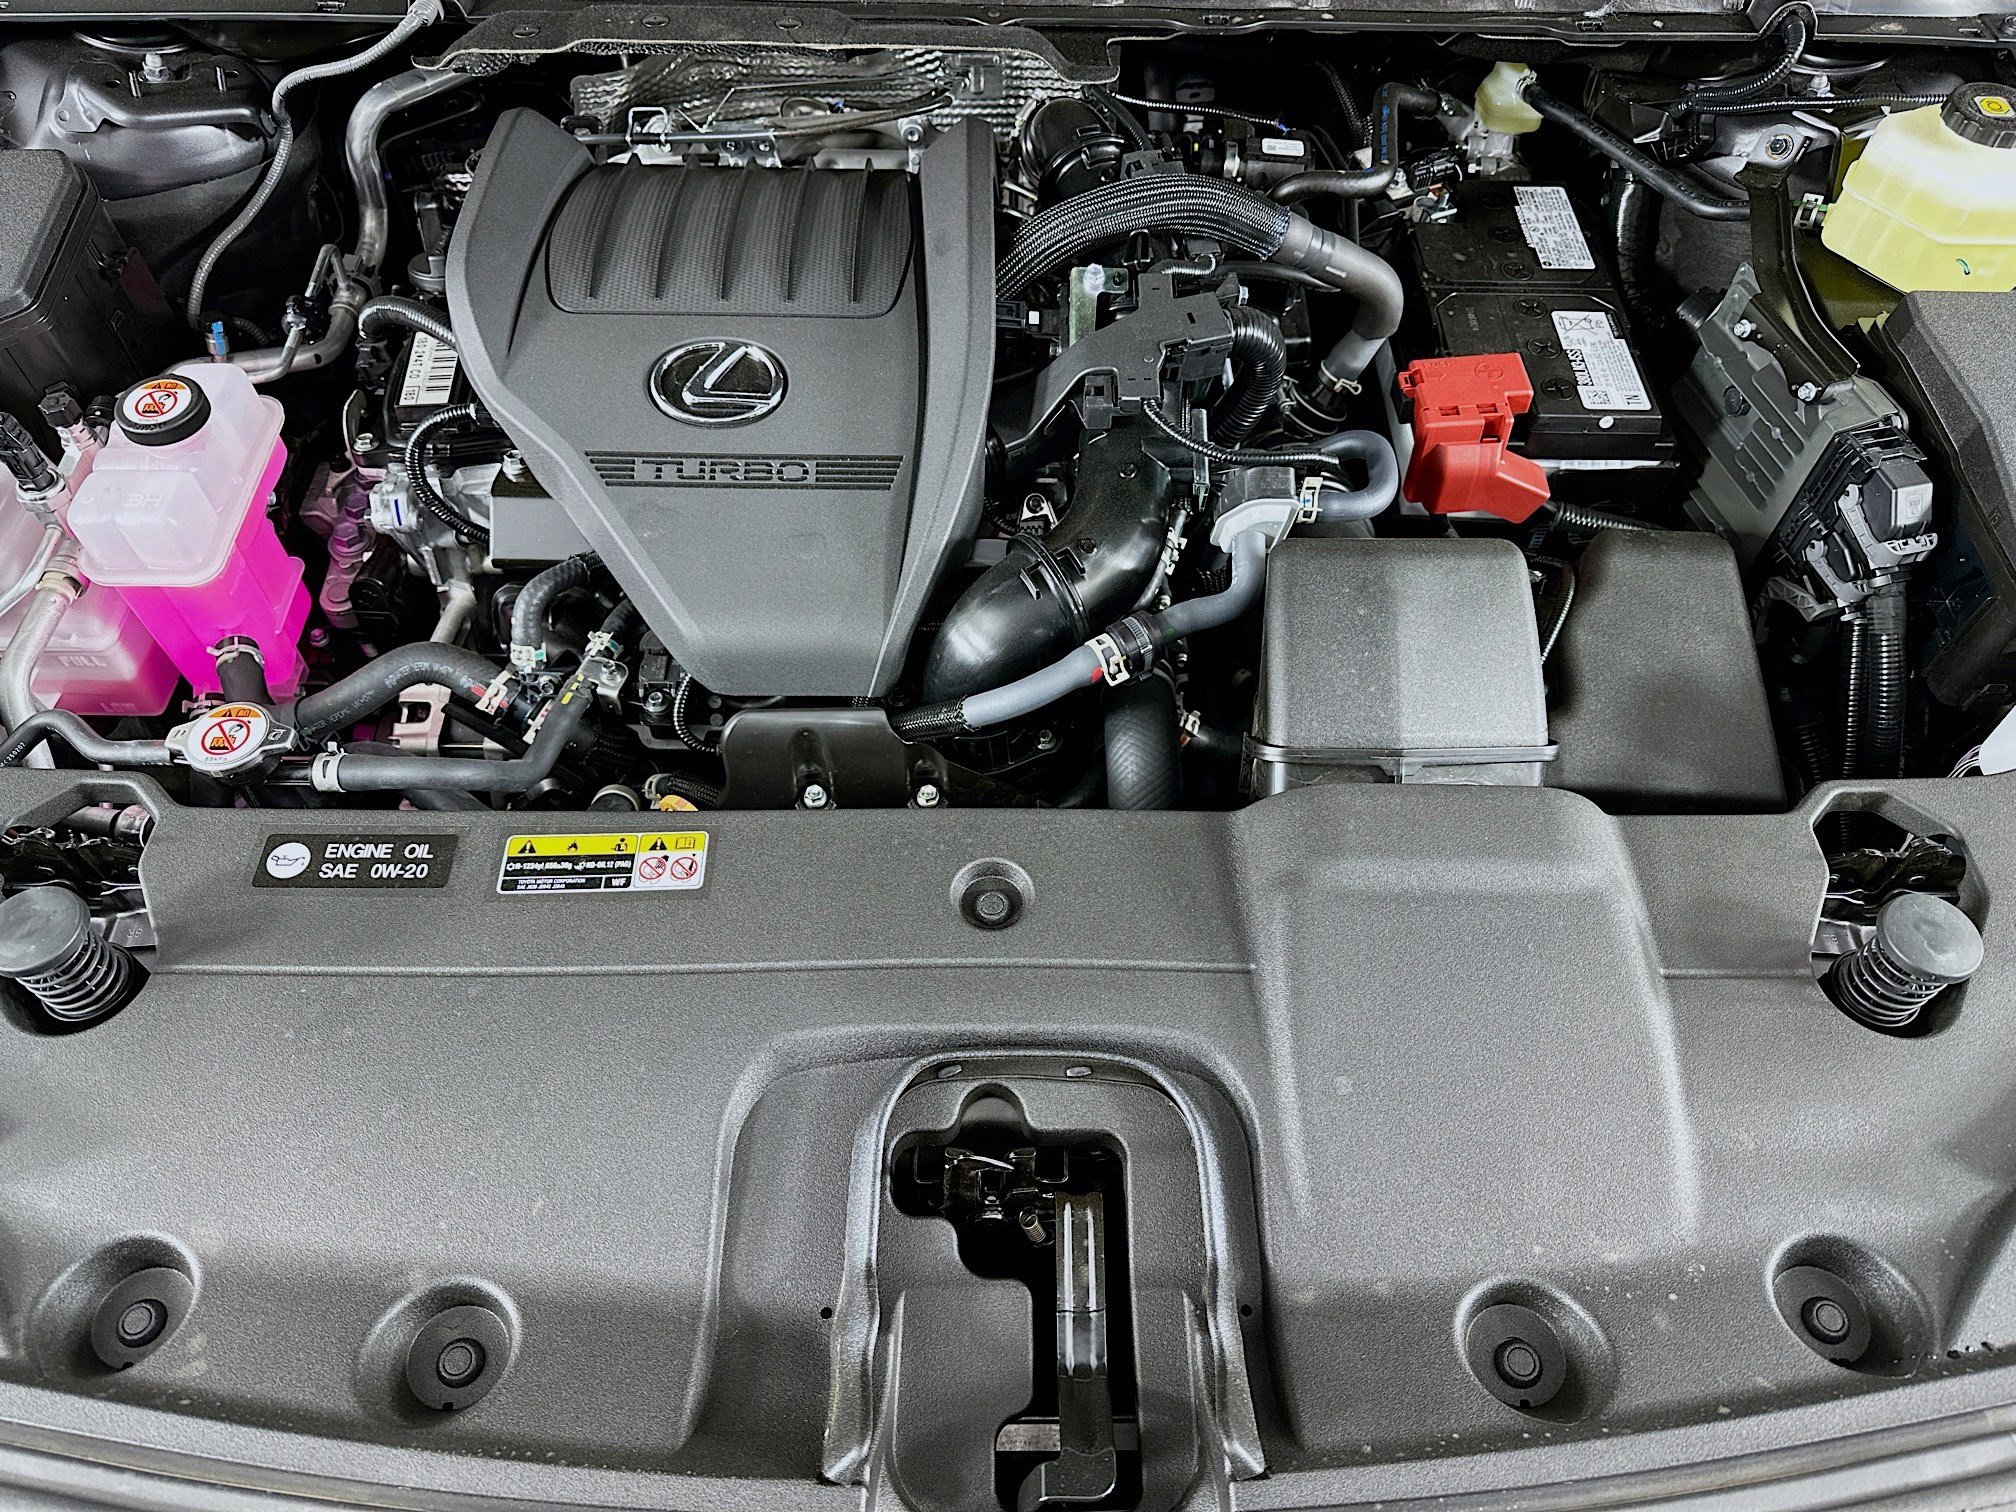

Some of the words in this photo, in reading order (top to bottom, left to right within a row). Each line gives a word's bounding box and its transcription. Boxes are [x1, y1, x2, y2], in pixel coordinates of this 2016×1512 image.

[1624, 394, 1642, 406] TN
[640, 459, 810, 482] TURBO
[57, 655, 107, 667] FULL
[324, 843, 394, 859] ENGINE
[403, 843, 434, 859] OIL
[318, 863, 359, 879] SAE
[370, 863, 429, 879] 0W-20
[611, 877, 627, 887] WF
